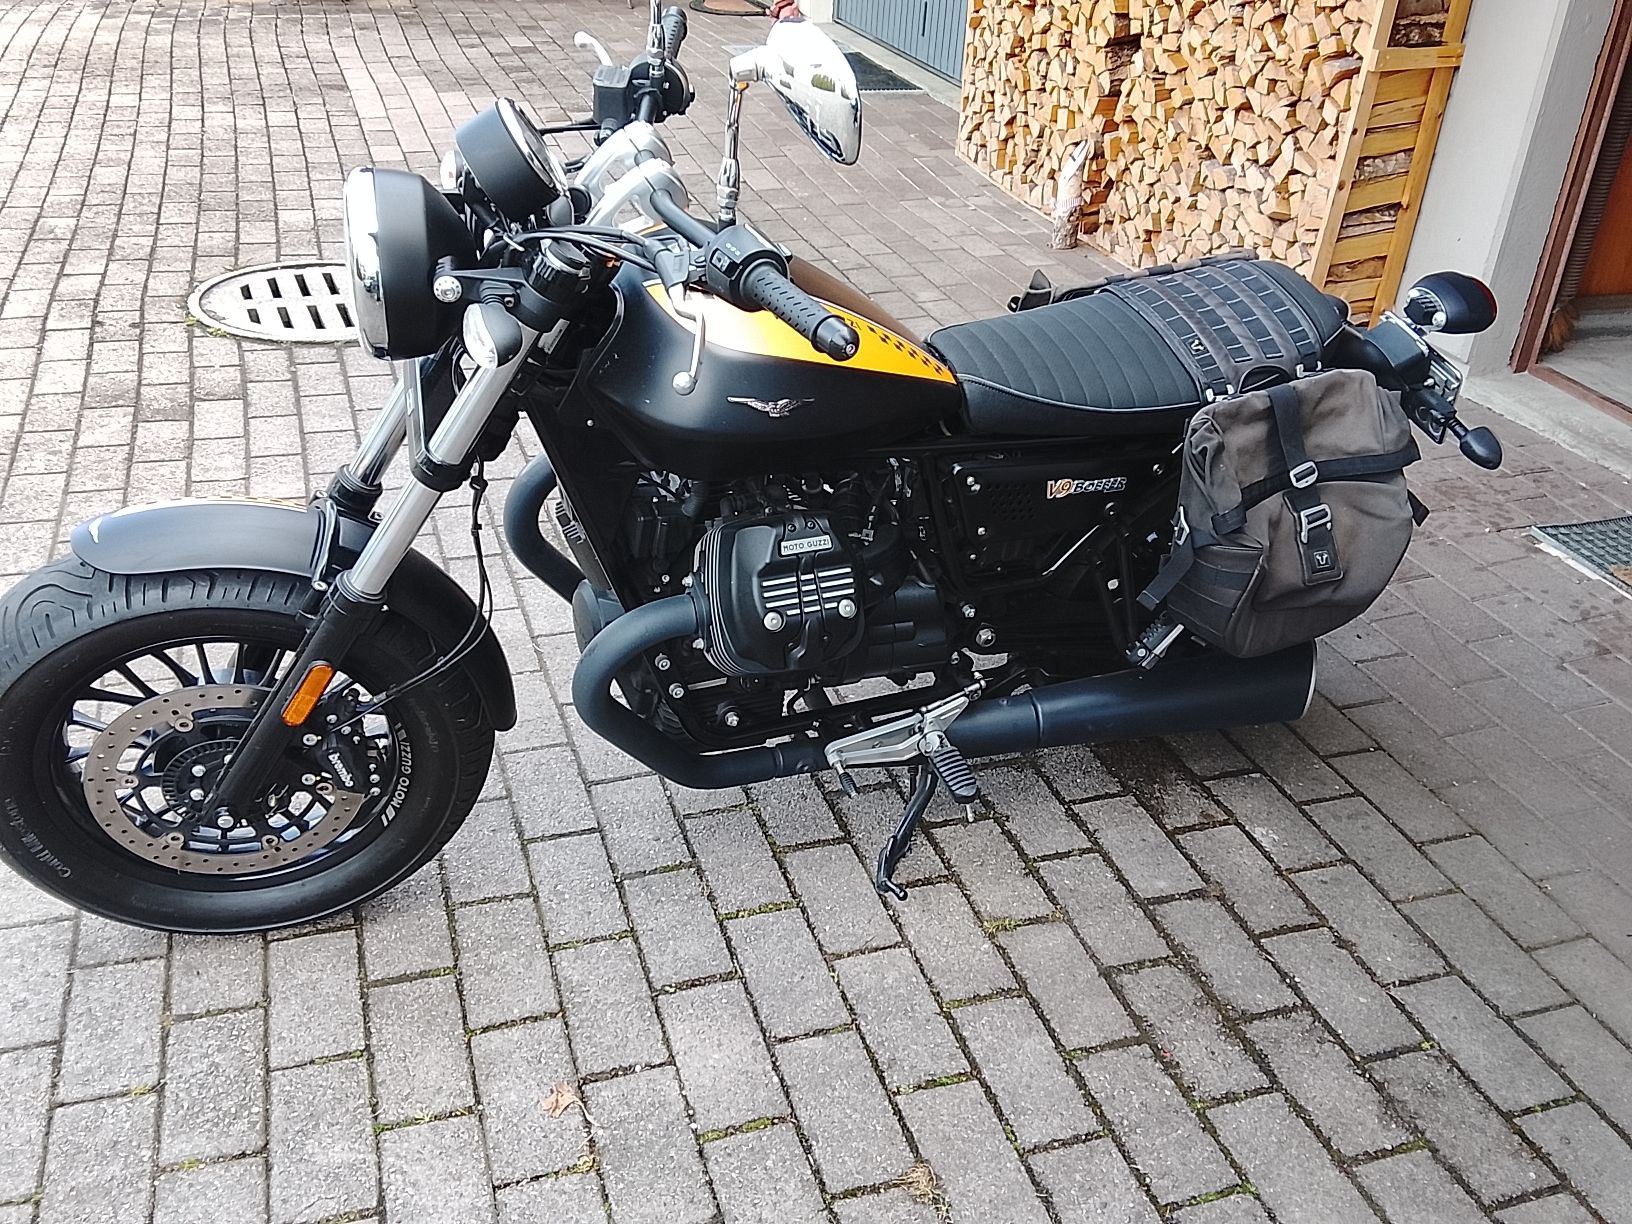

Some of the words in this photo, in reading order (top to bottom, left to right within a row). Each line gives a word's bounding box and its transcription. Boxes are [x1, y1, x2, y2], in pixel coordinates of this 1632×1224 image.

[1046, 478, 1074, 499] V9
[783, 542, 805, 552] MOTO
[806, 538, 830, 548] GUZZI
[328, 752, 354, 787] brembo
[390, 777, 410, 808] MOTO
[400, 741, 412, 775] GUZZI
